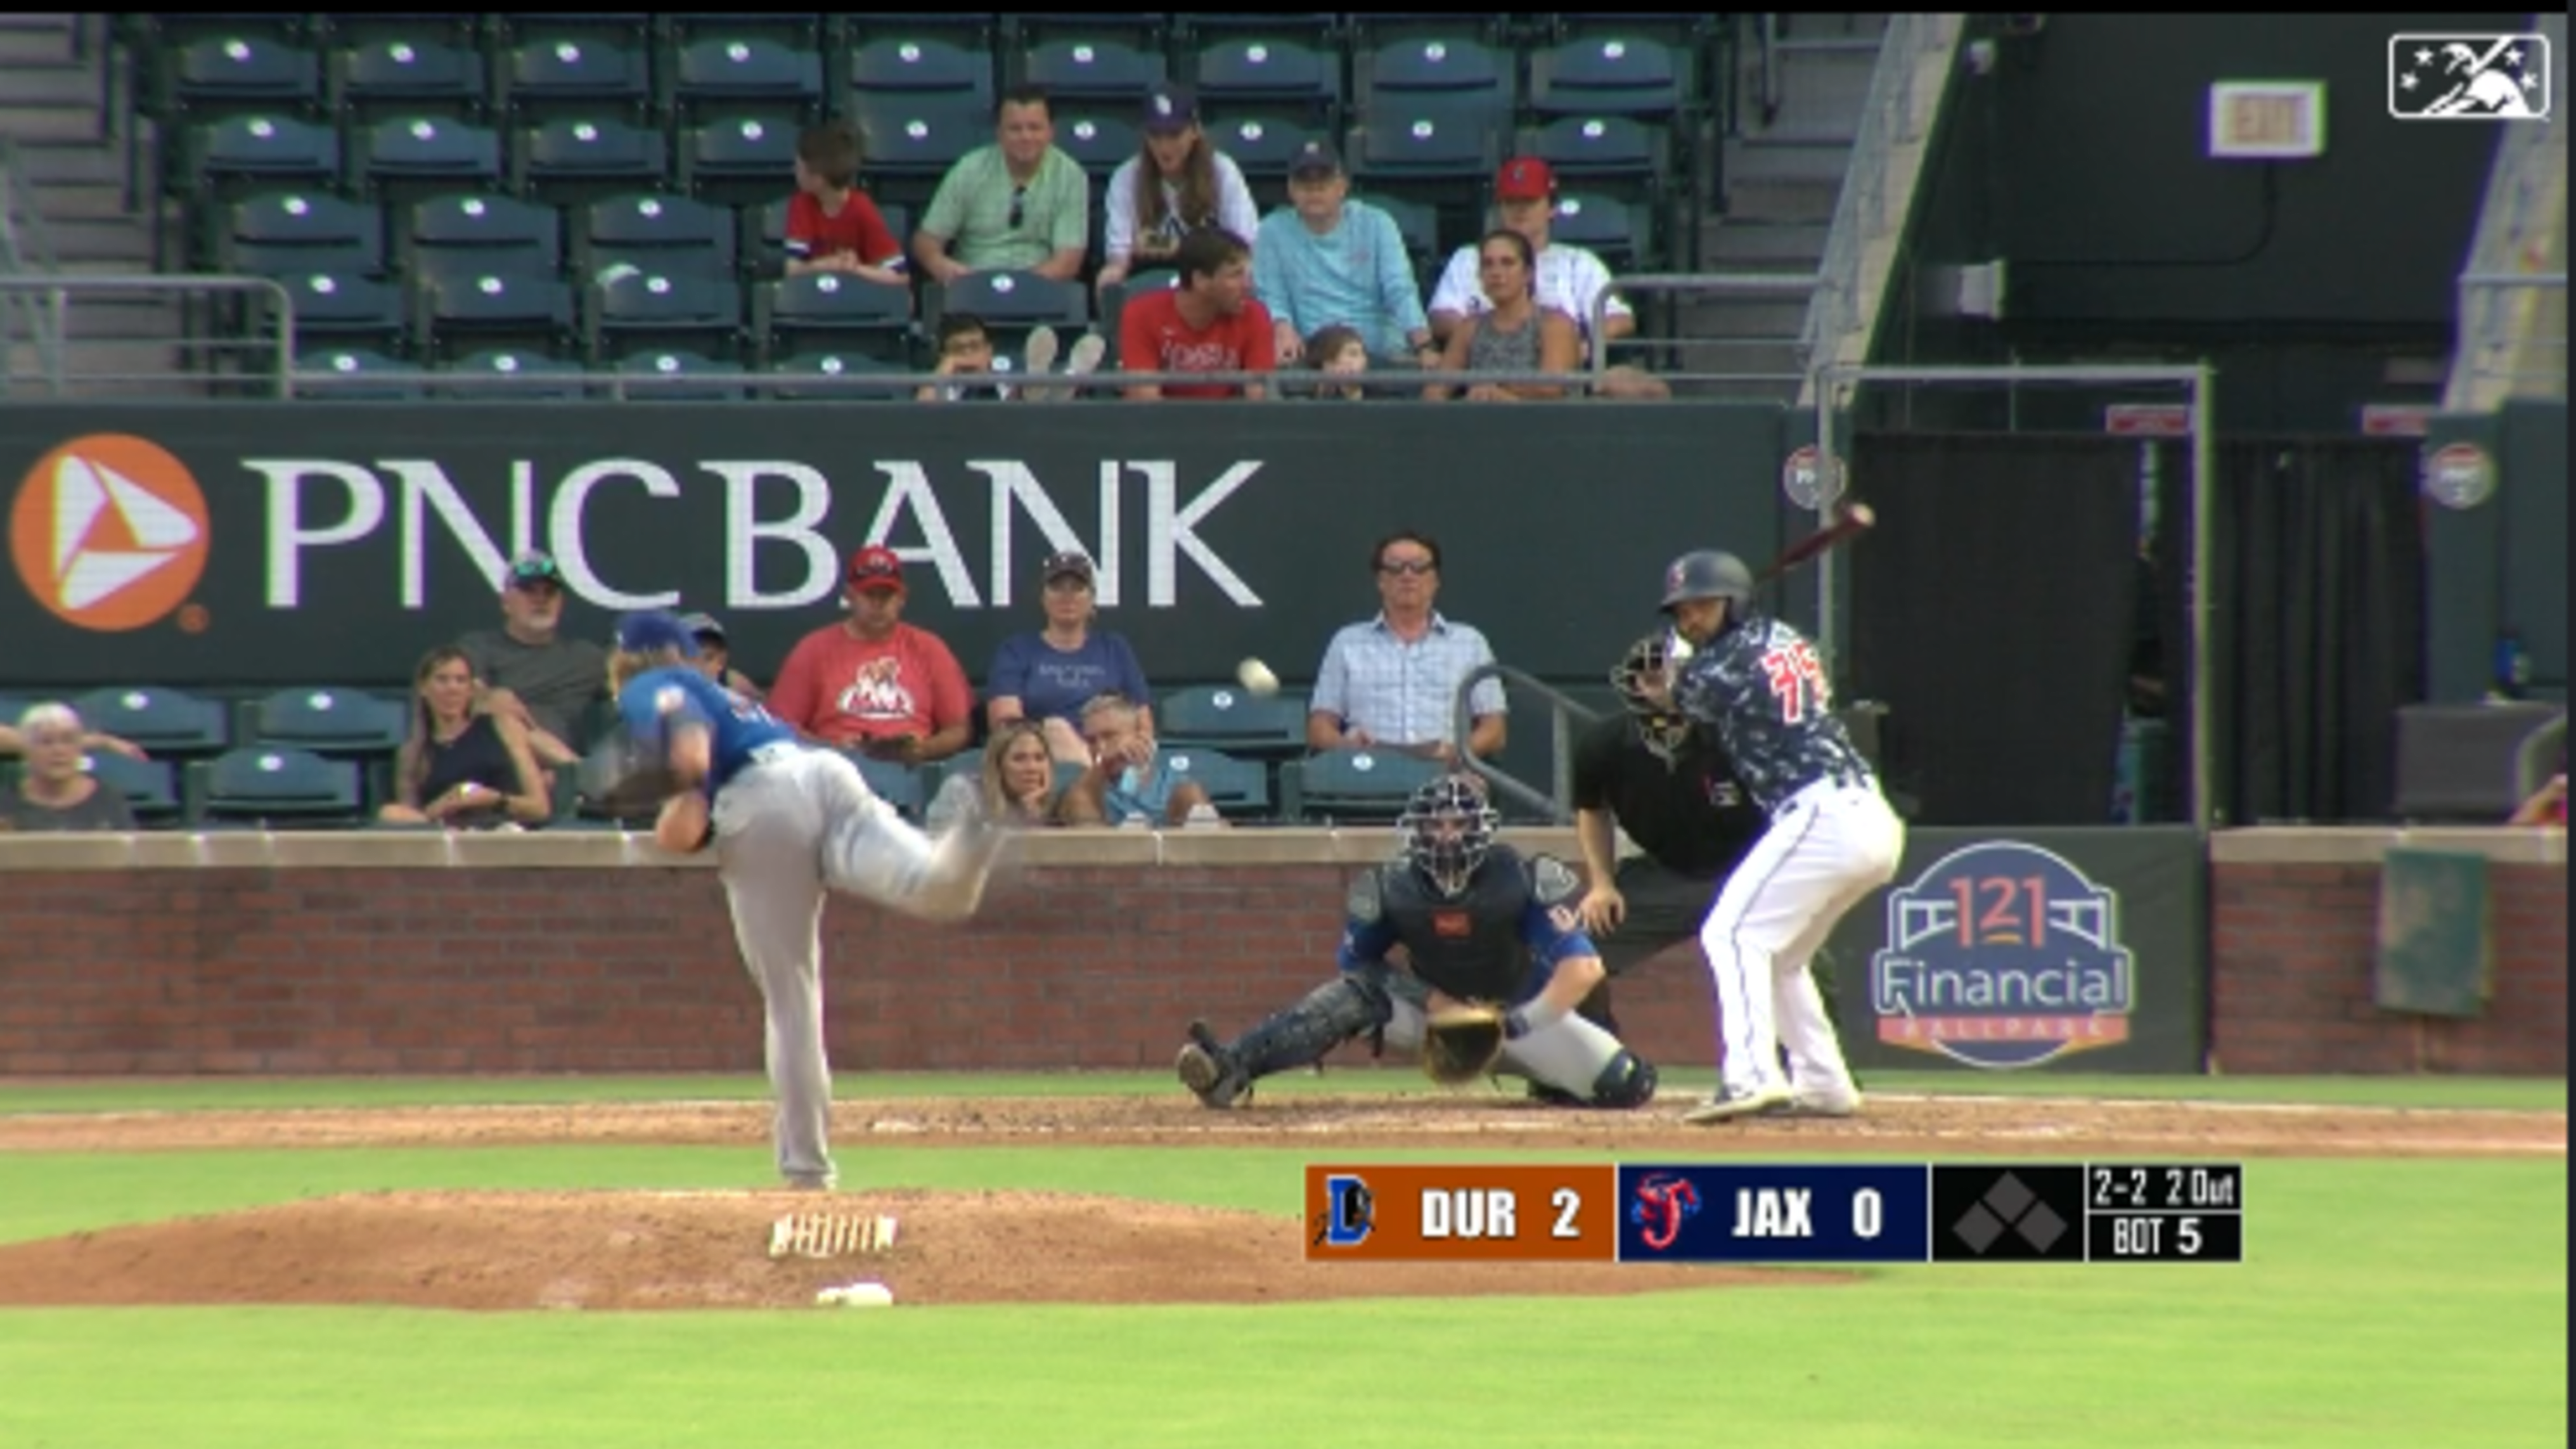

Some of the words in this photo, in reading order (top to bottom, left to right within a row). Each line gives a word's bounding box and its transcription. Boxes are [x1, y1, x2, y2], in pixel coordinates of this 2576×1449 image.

[242, 460, 681, 610] PNC
[698, 460, 1265, 610] BANK
[1949, 876, 2046, 948] 121
[1883, 958, 2125, 1005] Financial
